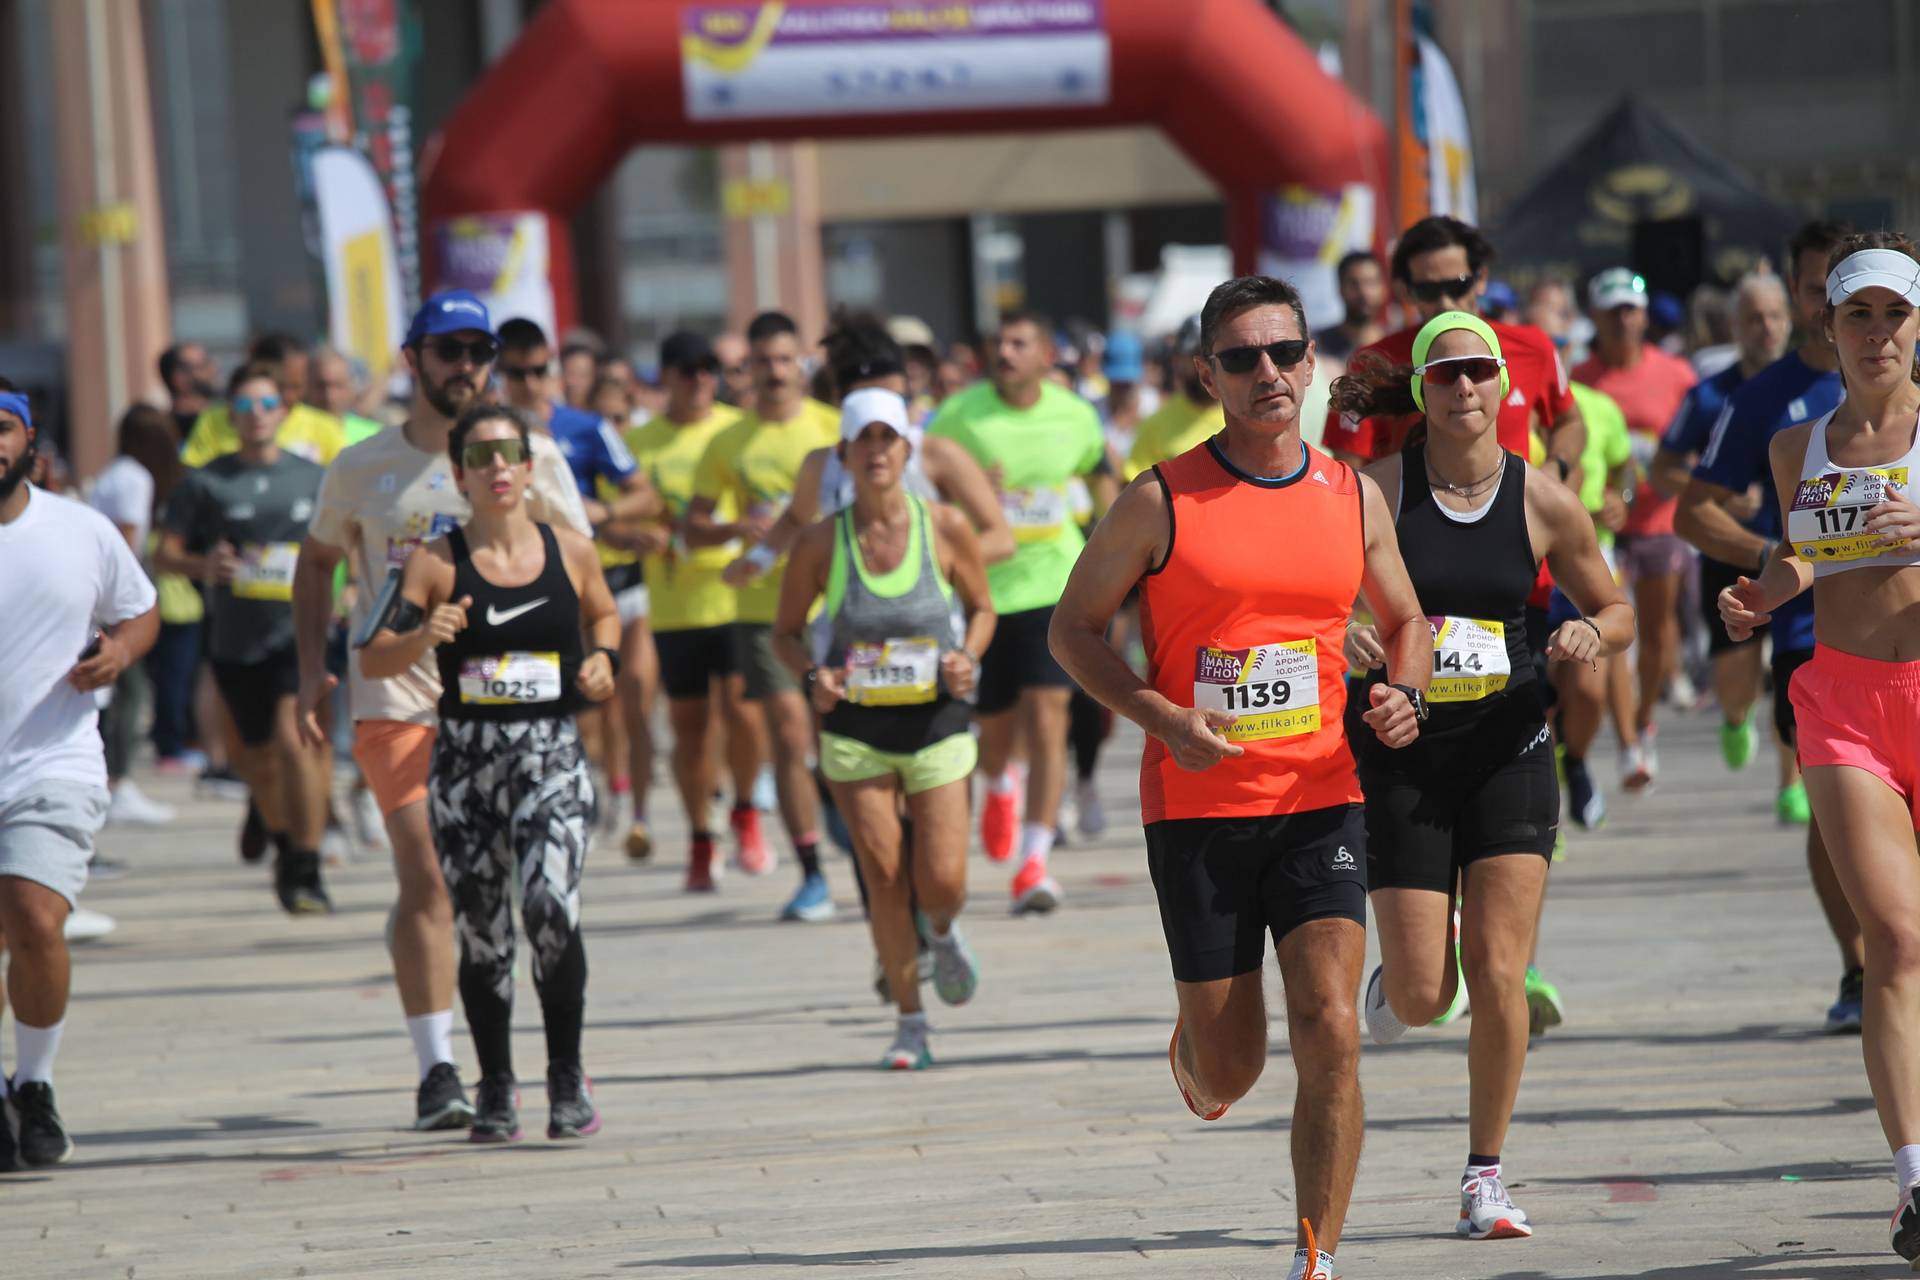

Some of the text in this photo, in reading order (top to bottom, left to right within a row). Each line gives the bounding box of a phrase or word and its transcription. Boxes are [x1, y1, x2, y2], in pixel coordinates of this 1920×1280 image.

[1275, 646, 1308, 657] ΑΓΩΝΑΣ
[1206, 656, 1242, 668] MARA
[1275, 655, 1309, 666] ΔΡΟΜΟΥ
[1205, 667, 1242, 679] THON
[1276, 665, 1310, 675] 10.000m
[481, 680, 538, 699] 1025
[1222, 680, 1291, 710] 1139
[1222, 714, 1314, 732] www.filkal.gr
